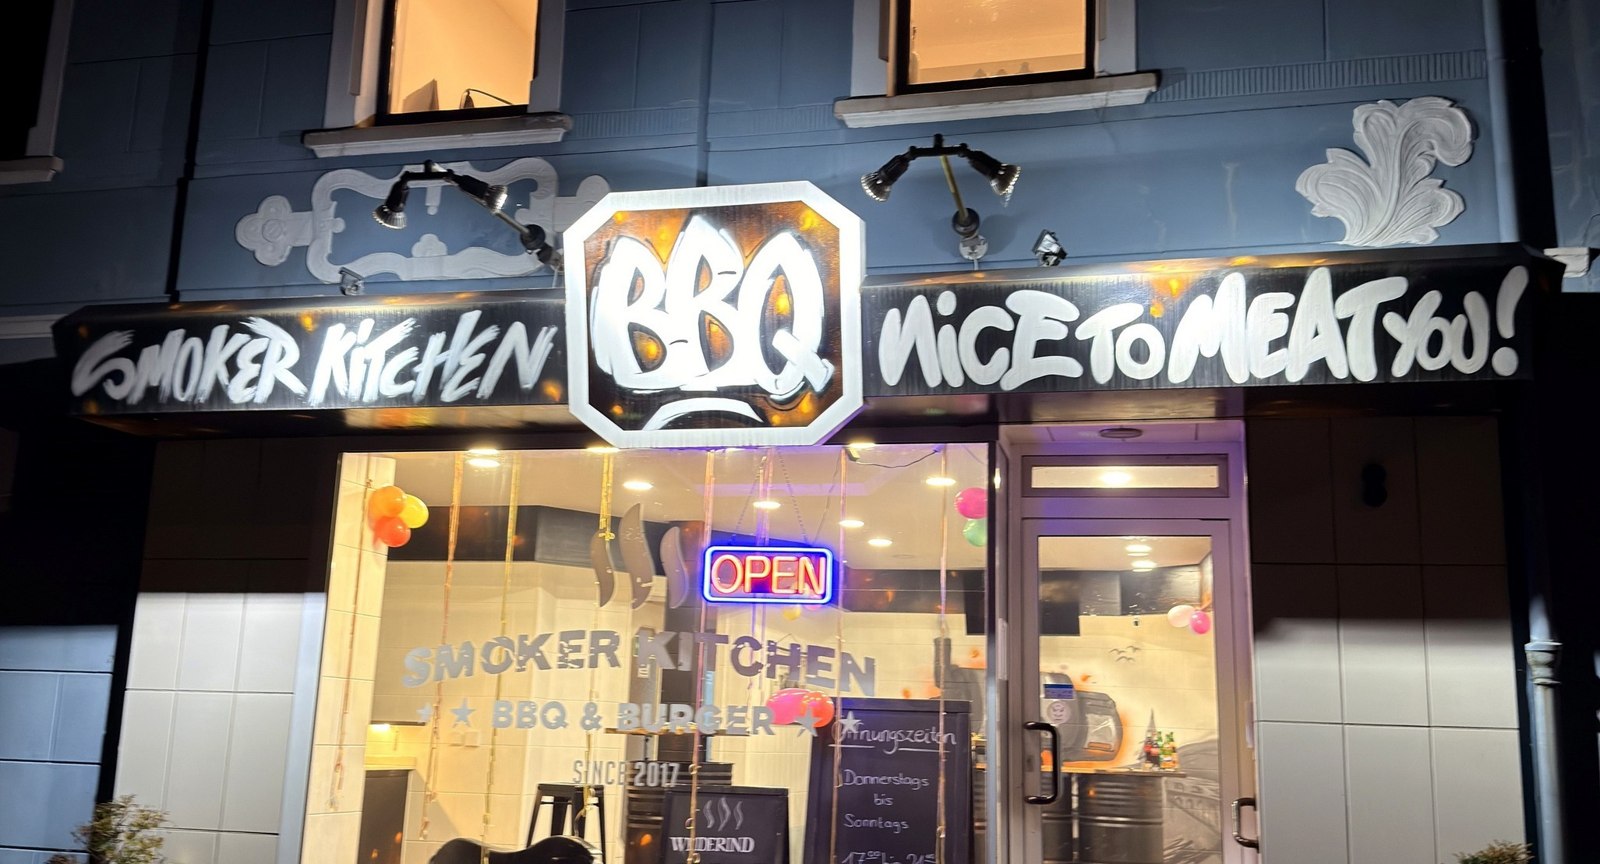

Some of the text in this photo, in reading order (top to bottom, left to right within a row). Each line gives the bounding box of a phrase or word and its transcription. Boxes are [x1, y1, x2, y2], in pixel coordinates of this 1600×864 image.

[590, 213, 834, 401] BBQ
[1168, 267, 1408, 384] MEAT
[70, 316, 308, 404] SMOKER
[711, 554, 826, 595] OPEN
[402, 630, 875, 697] SMOKER KITCHEN
[492, 700, 776, 735] BBQ & BURGER
[573, 760, 679, 787] SINCE 2017
[844, 769, 930, 790] Donnerstags
[873, 793, 894, 806] bis
[844, 814, 909, 833] Sonntags
